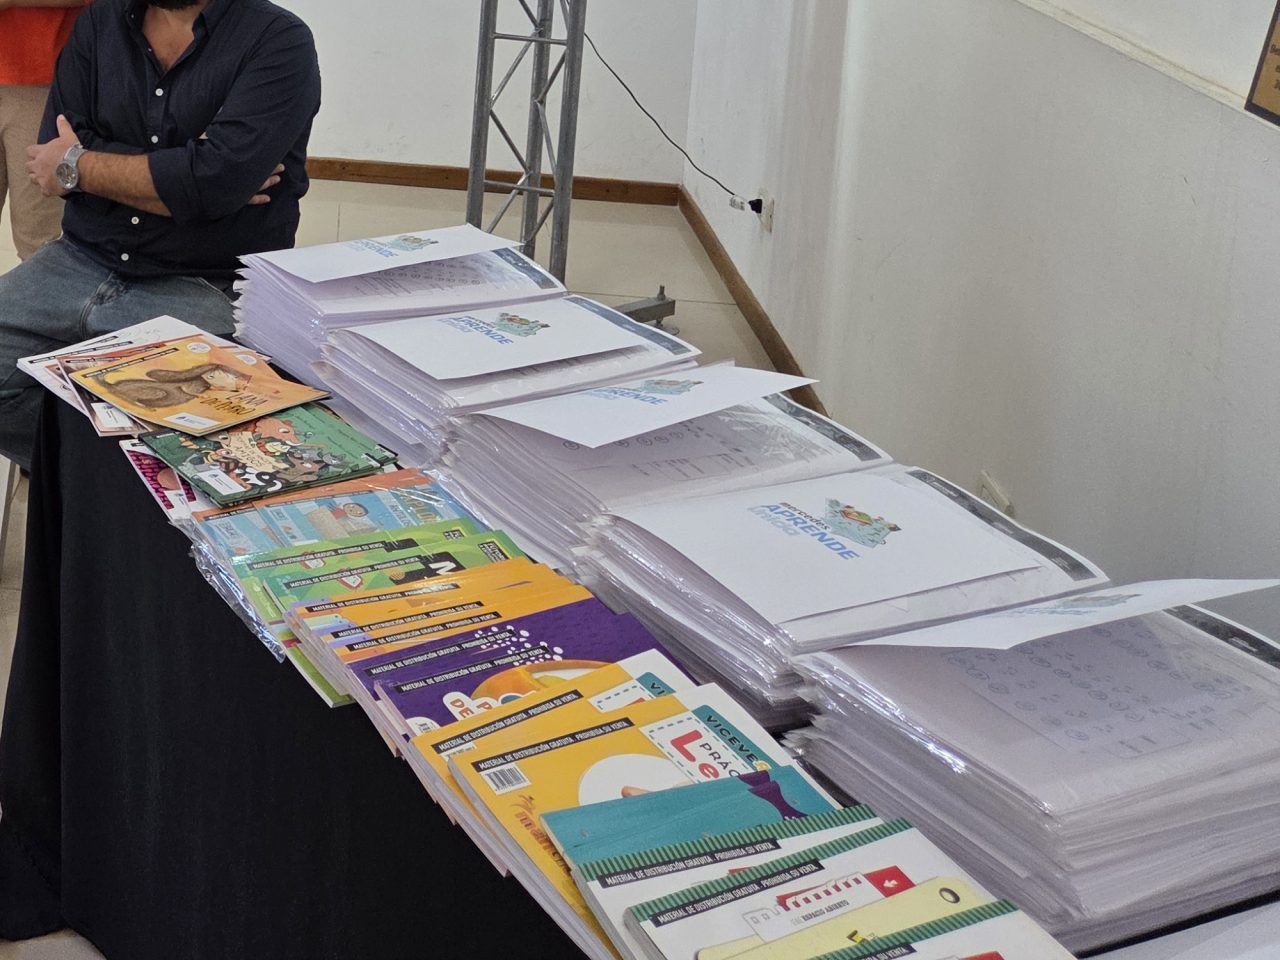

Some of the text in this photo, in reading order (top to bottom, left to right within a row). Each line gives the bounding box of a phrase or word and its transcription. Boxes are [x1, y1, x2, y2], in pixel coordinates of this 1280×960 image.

[759, 504, 861, 560] APRENDE
[401, 679, 426, 692] MATERIAL
[438, 736, 462, 751] MATERIAL
[478, 756, 504, 770] MATERIAL
[605, 871, 635, 886] MATERIAL
[685, 854, 712, 867] GRATUITA
[714, 847, 745, 861] PROHIBIDA
[657, 906, 686, 924] MATERIAL
[732, 881, 760, 898] GRATUITA
[761, 870, 791, 888] PROHIBIDA
